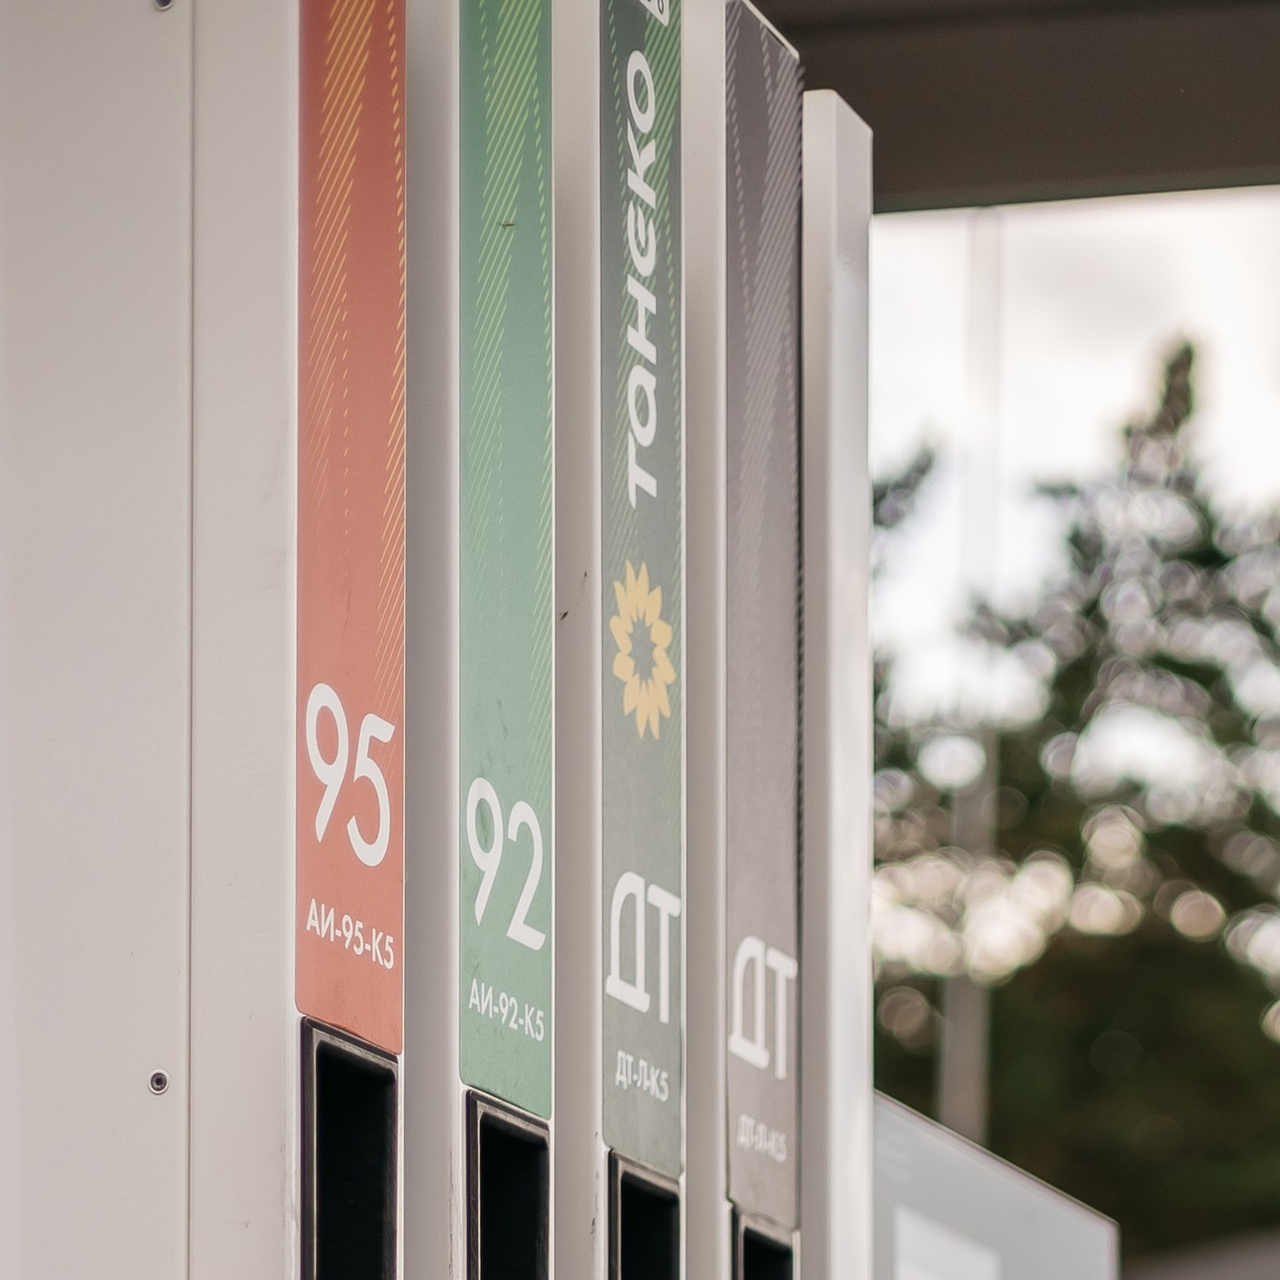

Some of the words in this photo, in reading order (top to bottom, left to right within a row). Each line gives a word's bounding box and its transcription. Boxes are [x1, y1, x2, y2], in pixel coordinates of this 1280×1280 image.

[306, 683, 396, 867] 95
[306, 898, 395, 970] АИ-95-К5
[466, 777, 546, 950] 92
[468, 977, 545, 1042] АИ-92-К5
[606, 871, 682, 1025] ДТ
[728, 935, 799, 1081] ДТ
